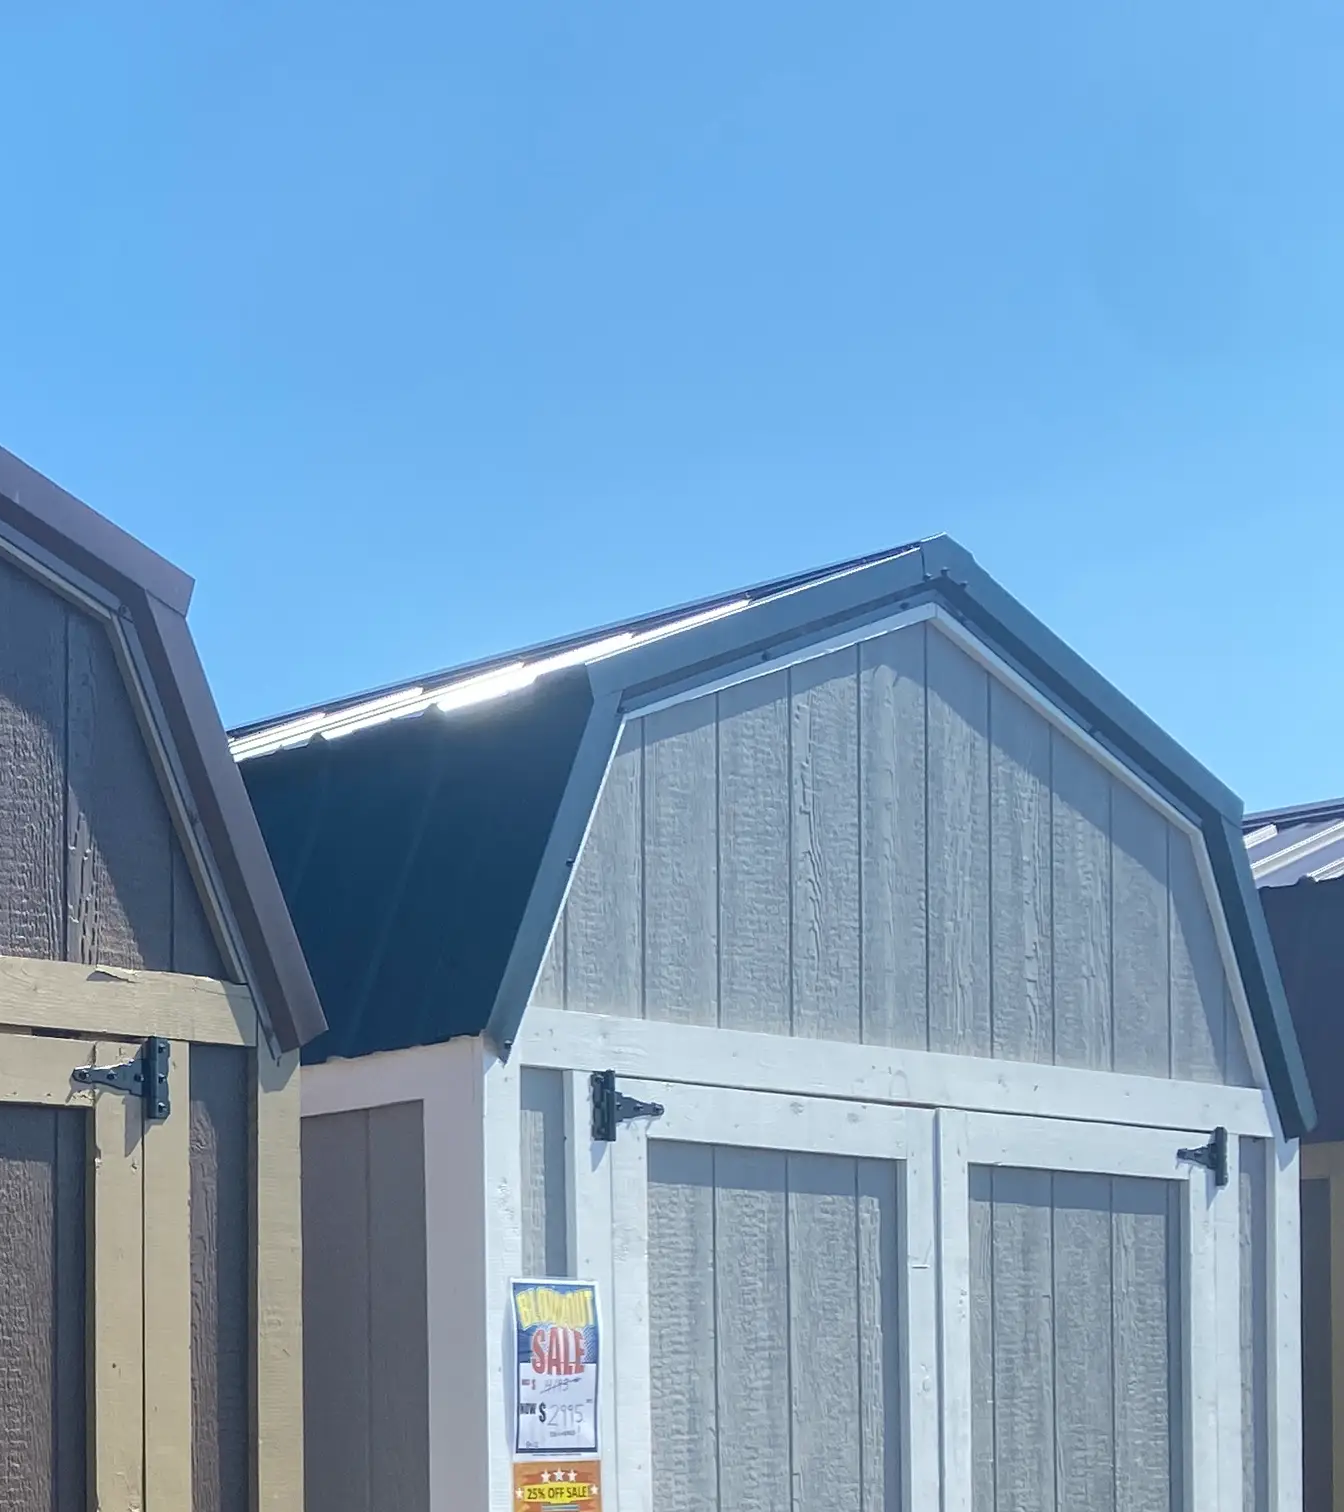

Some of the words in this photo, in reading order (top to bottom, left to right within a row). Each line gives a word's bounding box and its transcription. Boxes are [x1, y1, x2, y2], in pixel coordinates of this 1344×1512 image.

[516, 1288, 594, 1329] BLOWOUT
[532, 1326, 585, 1375] SALE
[539, 1402, 547, 1423] $
[547, 1404, 585, 1428] 2995
[527, 1489, 546, 1500] 25%
[548, 1488, 564, 1499] OFF
